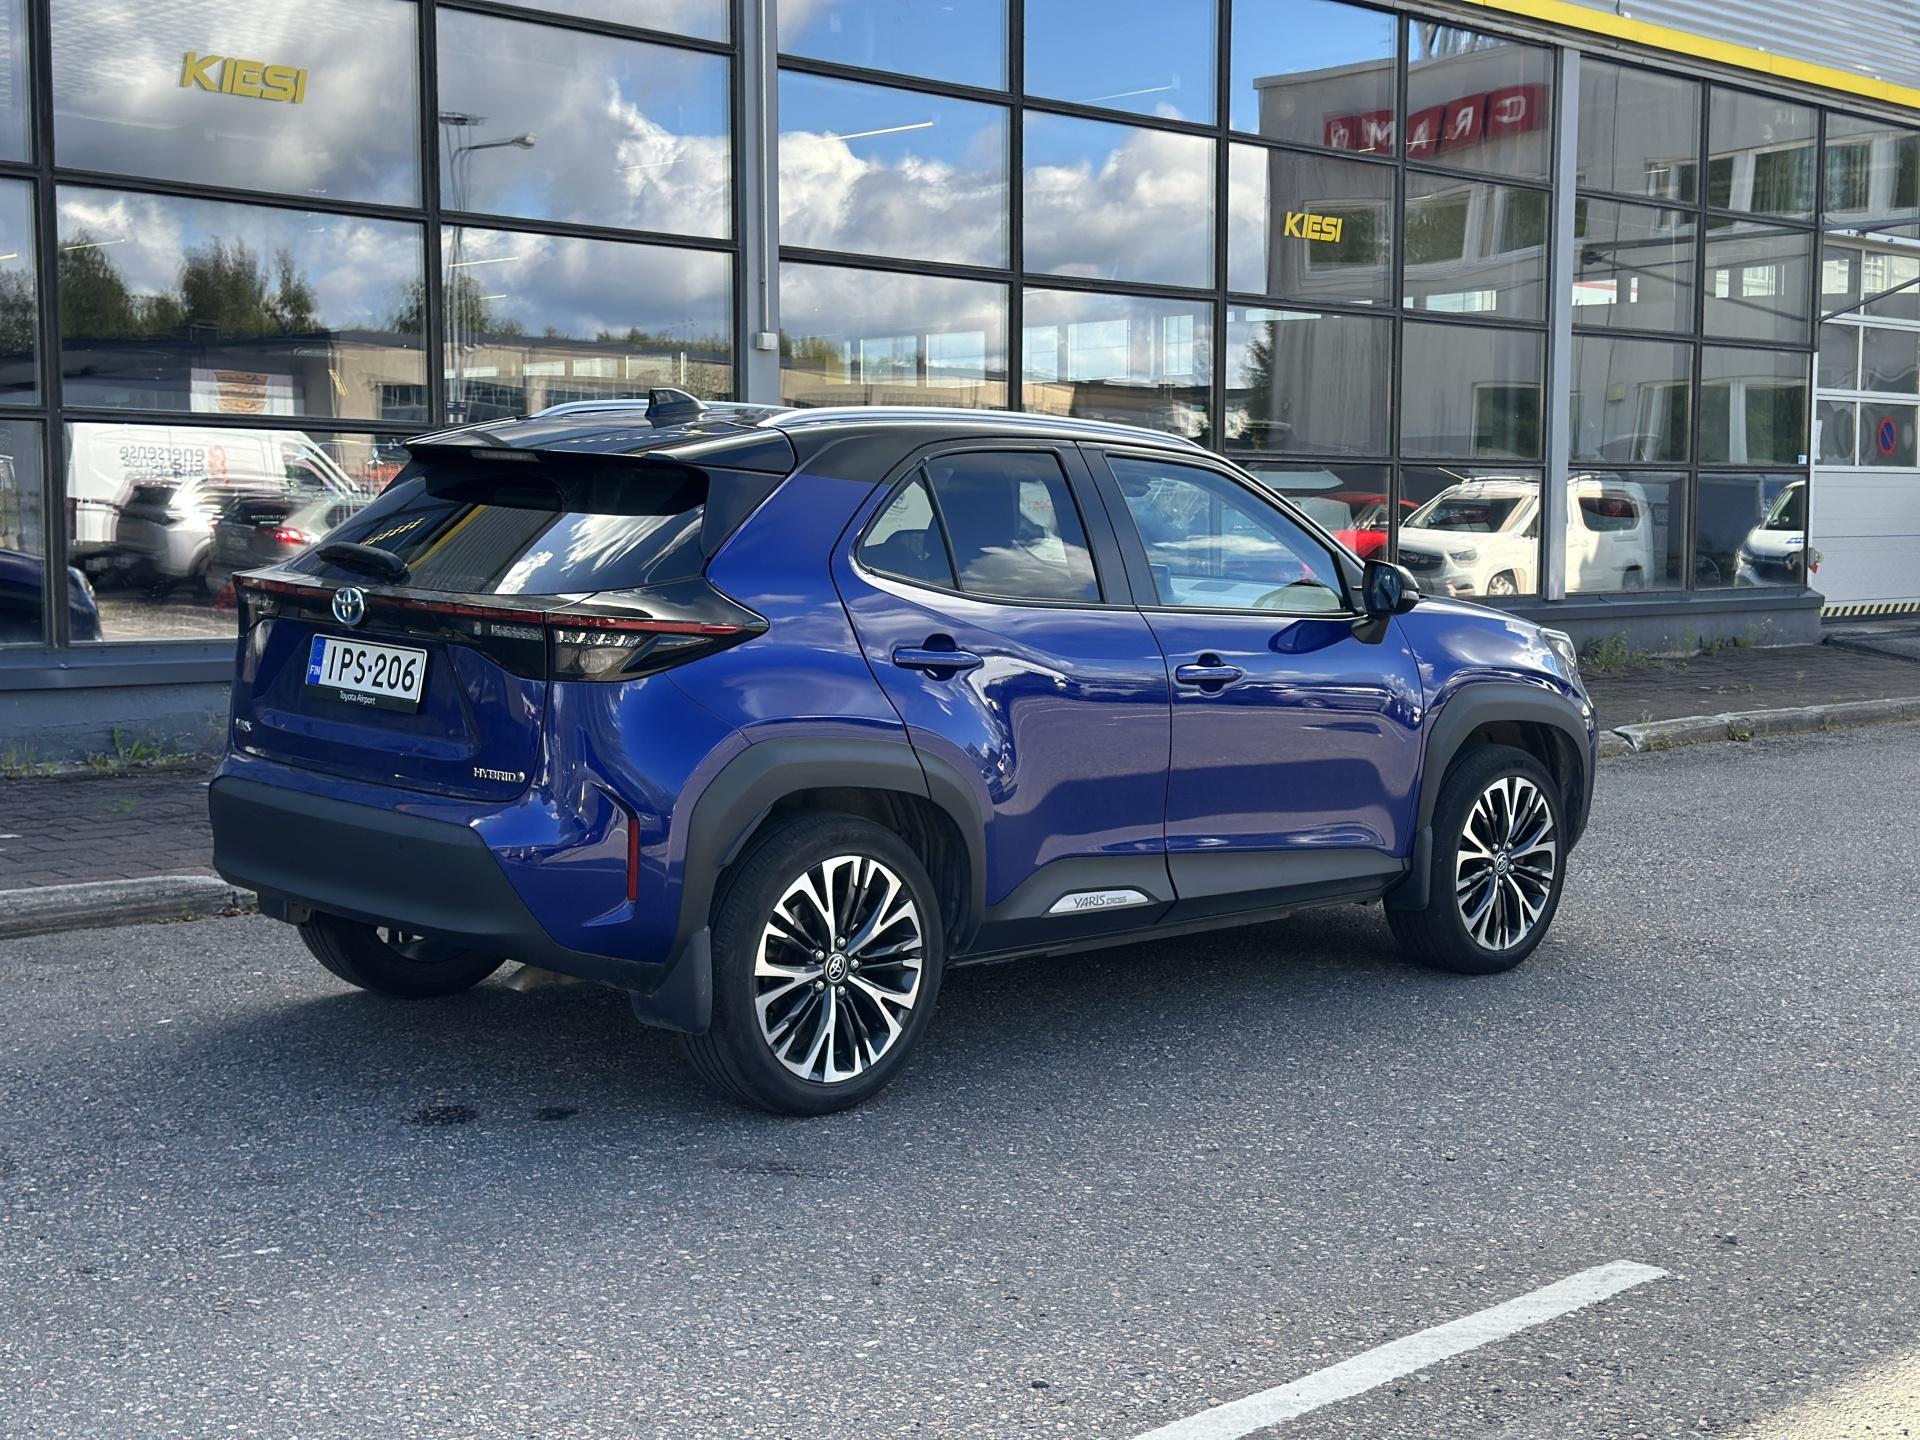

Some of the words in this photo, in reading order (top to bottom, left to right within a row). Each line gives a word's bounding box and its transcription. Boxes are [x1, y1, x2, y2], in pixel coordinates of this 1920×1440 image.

[179, 51, 307, 104] KIESI
[1284, 211, 1343, 243] KIESI
[309, 665, 321, 675] FIN
[328, 646, 417, 692] IPS-206
[340, 690, 357, 702] Toyota
[357, 693, 376, 705] Airport
[473, 767, 516, 782] HYBRID
[1074, 894, 1106, 908] YARIS
[1106, 895, 1127, 905] CROSS
